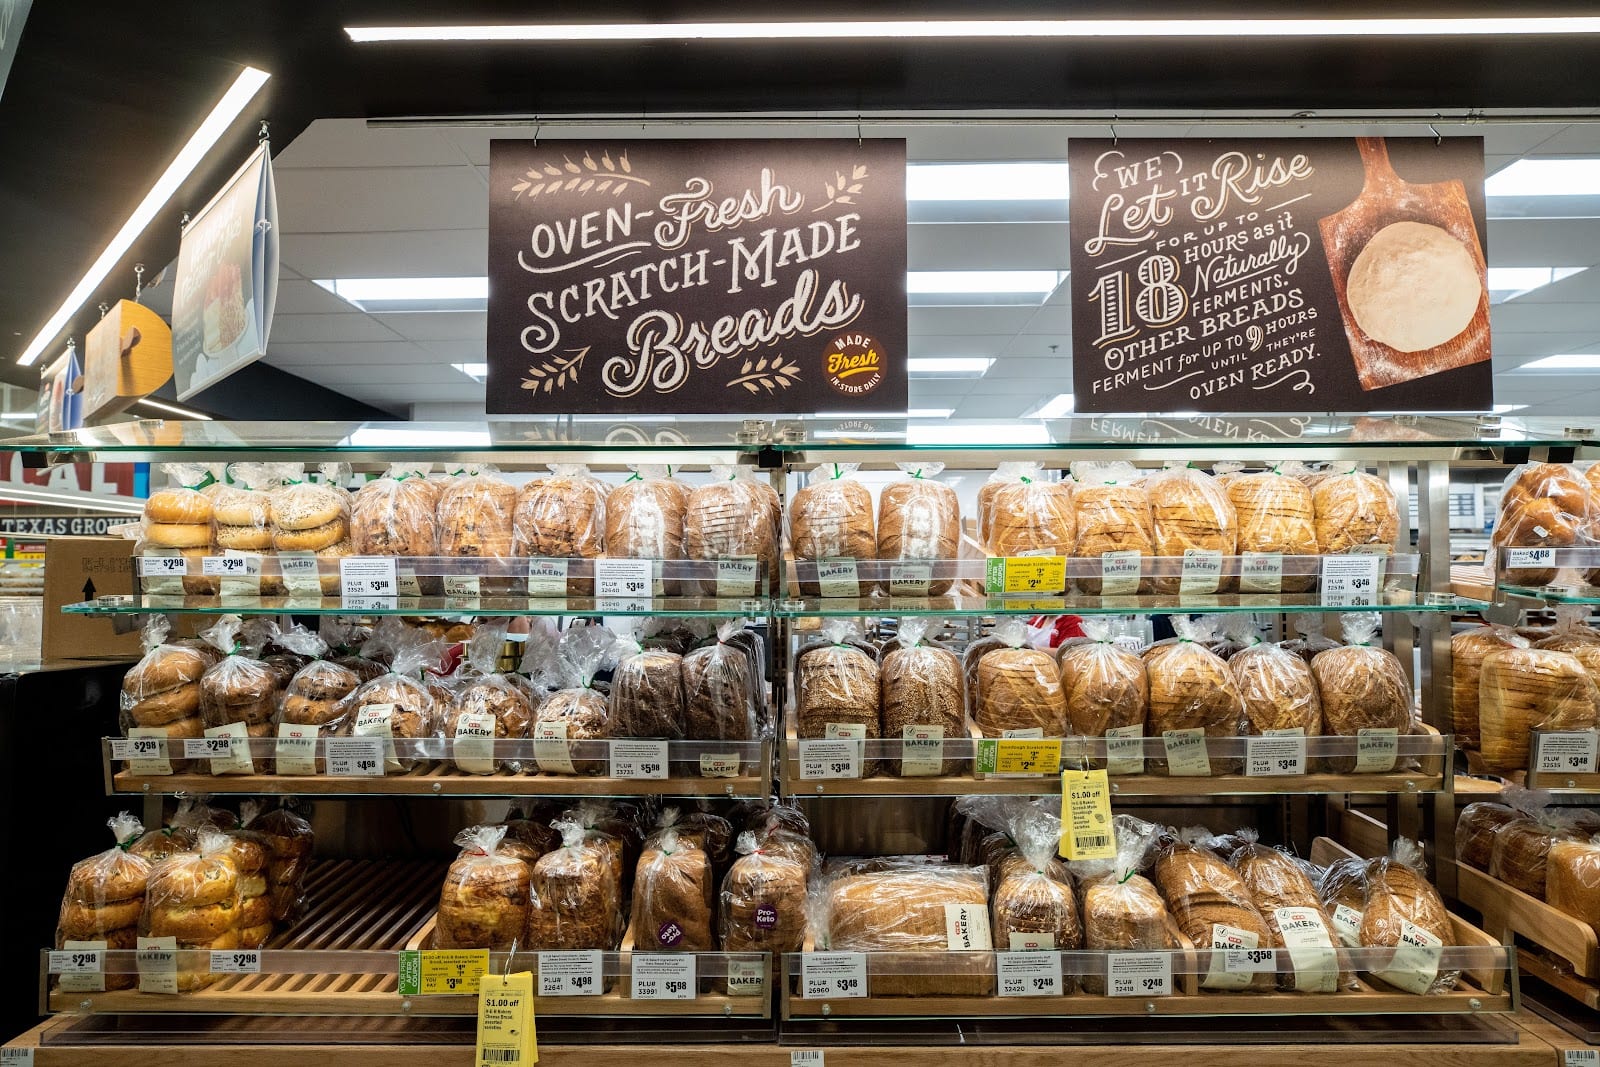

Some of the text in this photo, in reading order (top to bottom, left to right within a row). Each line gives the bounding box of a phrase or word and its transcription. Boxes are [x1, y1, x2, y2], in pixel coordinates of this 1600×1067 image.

[1113, 156, 1163, 189] WE
[1085, 151, 1315, 256] Let IT Rise
[1155, 211, 1260, 251] FOR UP TO
[1184, 211, 1294, 265] HOURS as it
[1190, 231, 1311, 298] Naturally
[520, 212, 863, 354] SCRATCH-MADE
[1088, 254, 1189, 348] 18
[1192, 273, 1289, 317] FERMENTS.
[602, 268, 865, 398] Breads
[1104, 287, 1304, 371] OTHER BREADS
[834, 334, 871, 351] MADE
[1211, 327, 1317, 371] UNTIL THEY'RE
[1092, 307, 1318, 395] FERMENT for UP TO 9 HOURS
[828, 348, 880, 374] Fresh
[1189, 342, 1321, 400] OVEN READY.
[830, 372, 881, 393] IN-STORE DAILY
[1, 518, 68, 535] TEXAS
[282, 560, 315, 570] BAKERY
[719, 562, 754, 572] BAKERY
[1104, 564, 1138, 574] BAKERY
[1184, 561, 1219, 572] BAKERY
[1244, 563, 1280, 573] BAKERY
[530, 569, 565, 577] BAKERY
[819, 566, 854, 578] BAKERY
[358, 717, 388, 727] BAKERY
[457, 728, 492, 737] BAKERY
[279, 739, 313, 747] BAKERY
[905, 739, 940, 748] BAKERY
[1108, 739, 1140, 751] BAKERY
[1166, 738, 1201, 751] BAKERY
[1359, 742, 1395, 750] BAKERY
[1071, 791, 1091, 799] $1.00
[1281, 920, 1320, 931] BAKERY
[1336, 913, 1357, 927] BAK
[959, 908, 971, 948] BAKERY
[1214, 941, 1249, 949] BAKE
[138, 951, 171, 962] BAKERY
[486, 998, 519, 1007] $1.00 off
